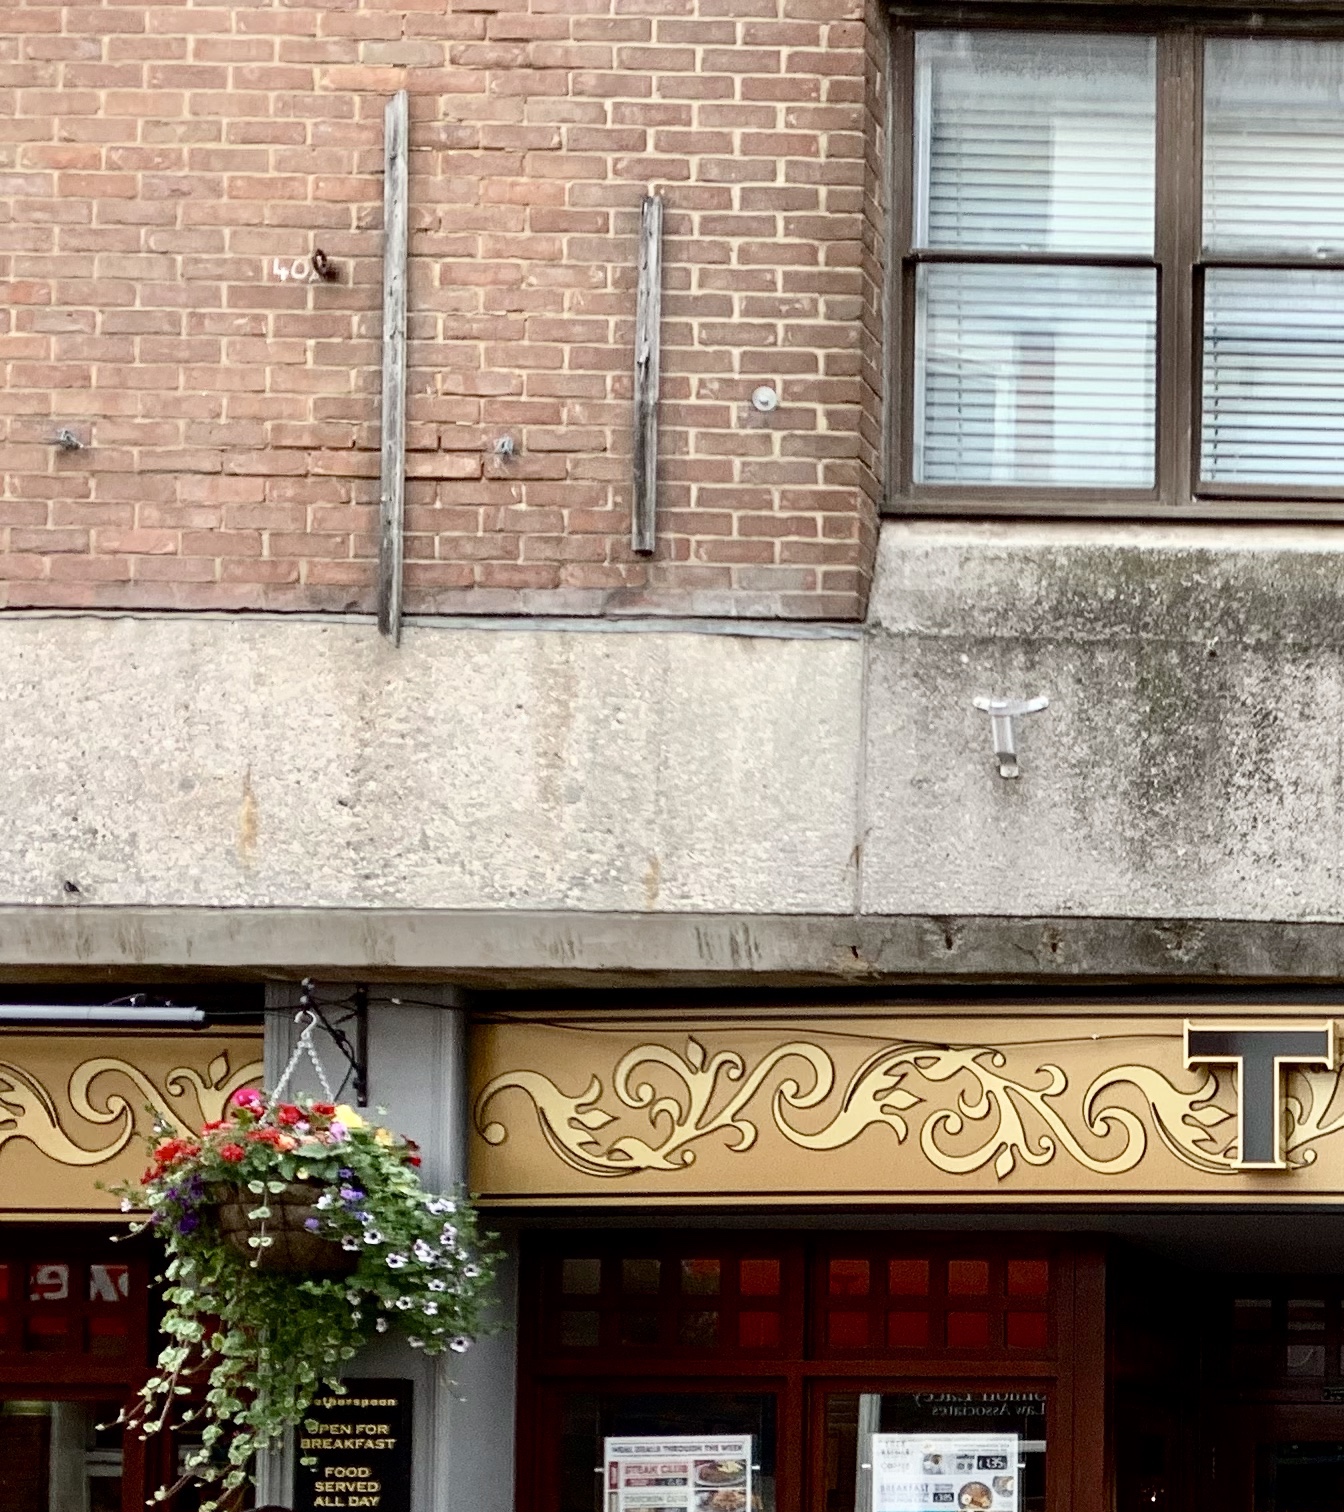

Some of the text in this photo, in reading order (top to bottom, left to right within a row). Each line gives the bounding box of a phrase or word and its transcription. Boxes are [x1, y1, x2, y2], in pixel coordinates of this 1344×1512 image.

[355, 1423, 389, 1435] FOR
[300, 1438, 398, 1449] BREAKFAST
[325, 1467, 371, 1477] FOOD
[315, 1482, 381, 1493] SERVED
[314, 1496, 381, 1507] ALL DAY
